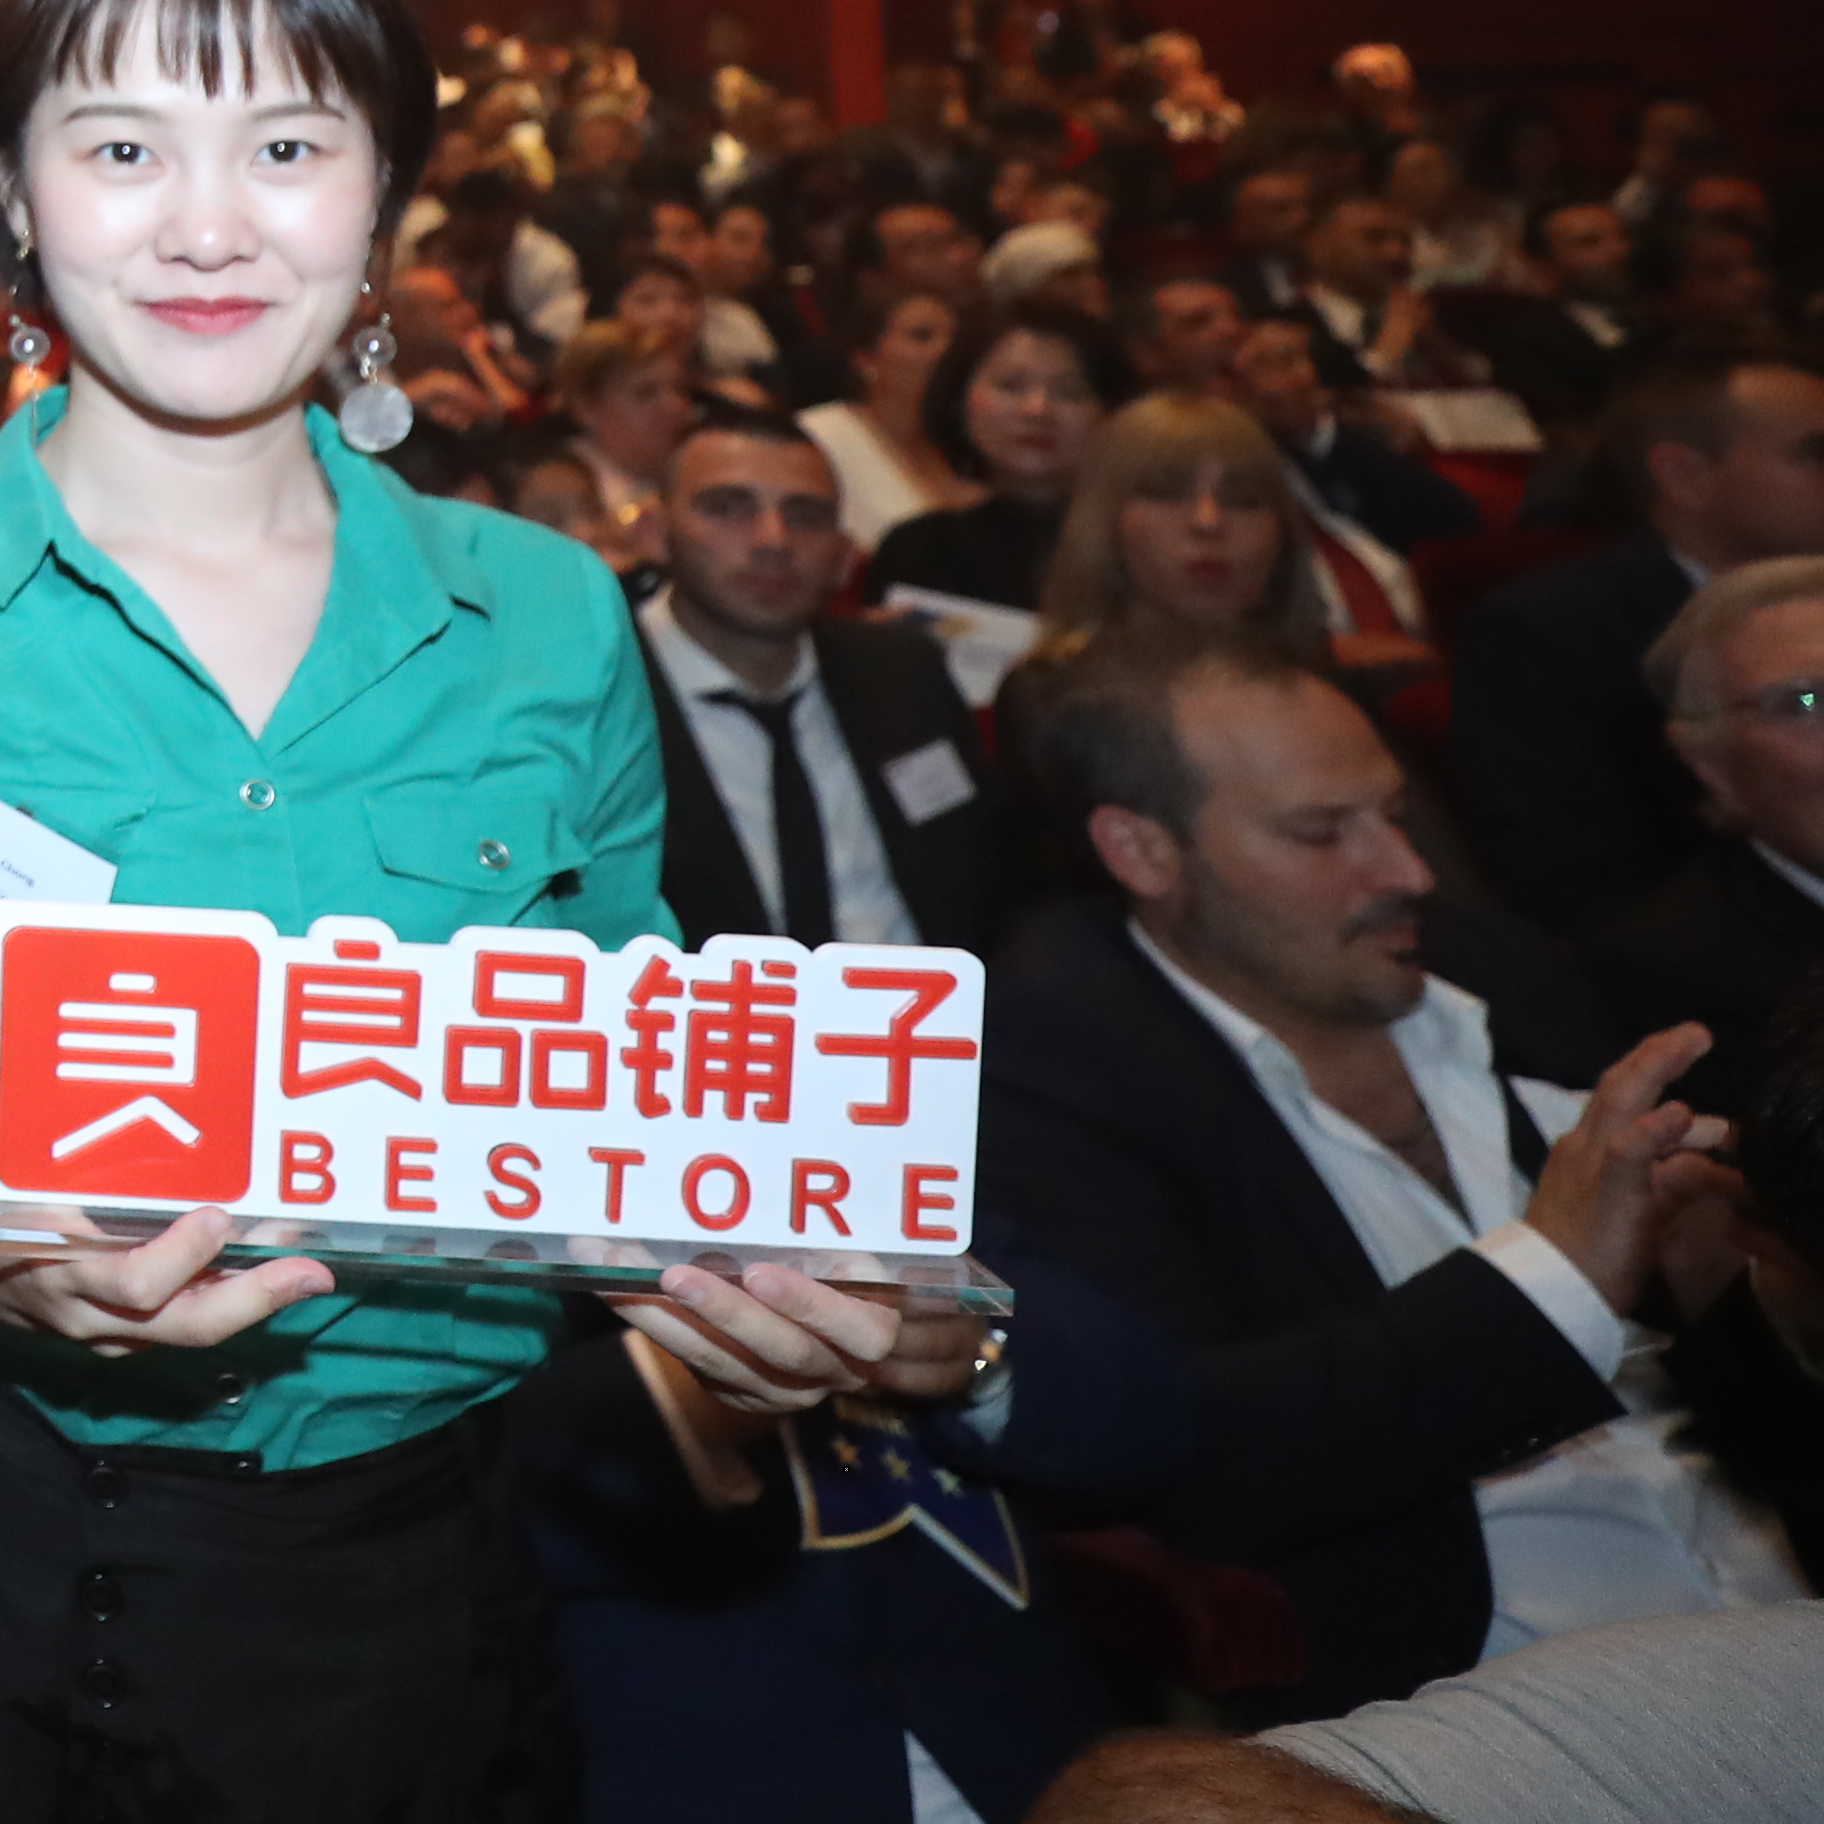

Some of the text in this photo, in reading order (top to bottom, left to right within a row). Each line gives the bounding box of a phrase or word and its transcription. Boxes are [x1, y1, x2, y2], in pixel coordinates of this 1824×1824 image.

[279, 938, 978, 1127] 良品铺子
[278, 1130, 959, 1242] BESTORE
